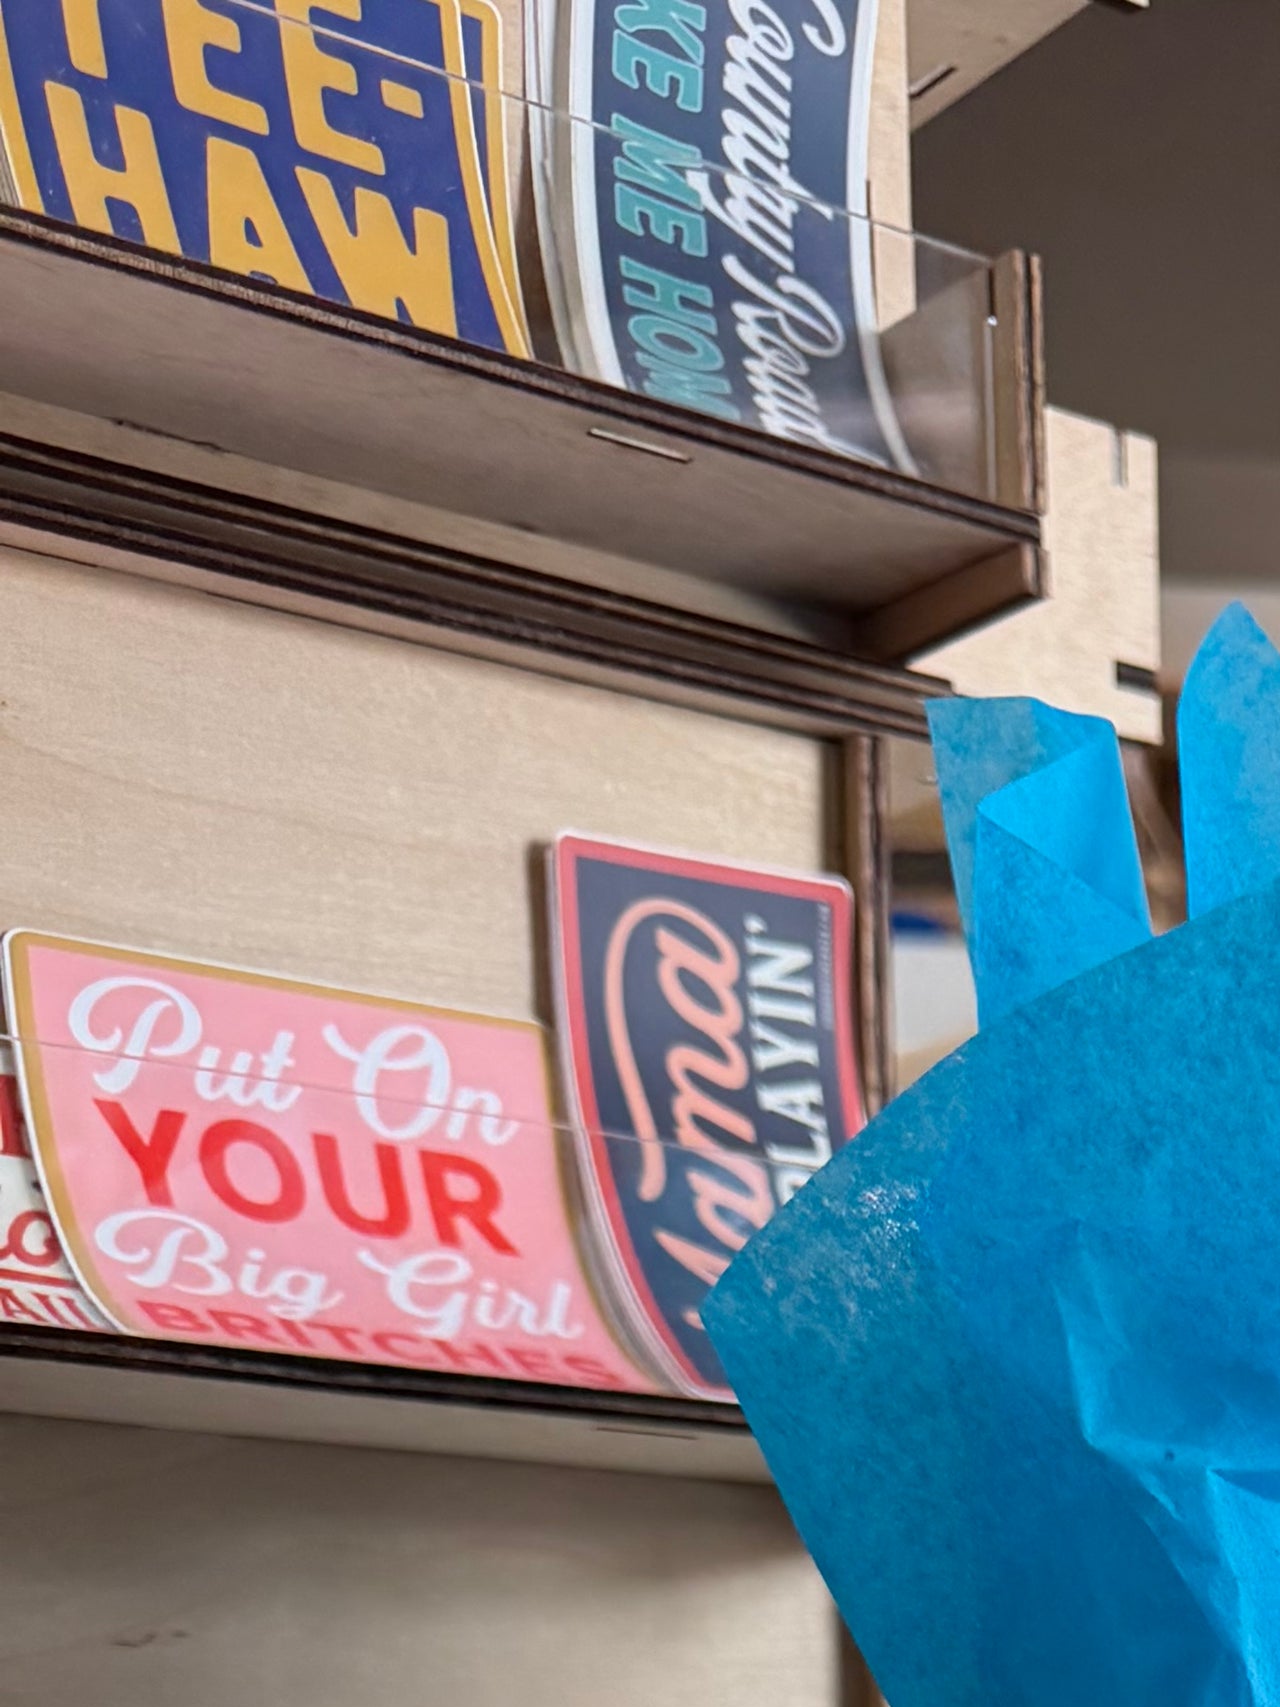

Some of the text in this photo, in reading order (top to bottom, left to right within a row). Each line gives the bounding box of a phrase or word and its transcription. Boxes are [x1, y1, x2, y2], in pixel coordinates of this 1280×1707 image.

[44, 80, 458, 338] HAW
[611, 112, 707, 258] ME
[68, 976, 520, 1146] Put On
[93, 1097, 521, 1257] YOUR
[94, 1209, 344, 1319] Big
[356, 1249, 584, 1339] Girl
[135, 1300, 628, 1388] BRITCHES
